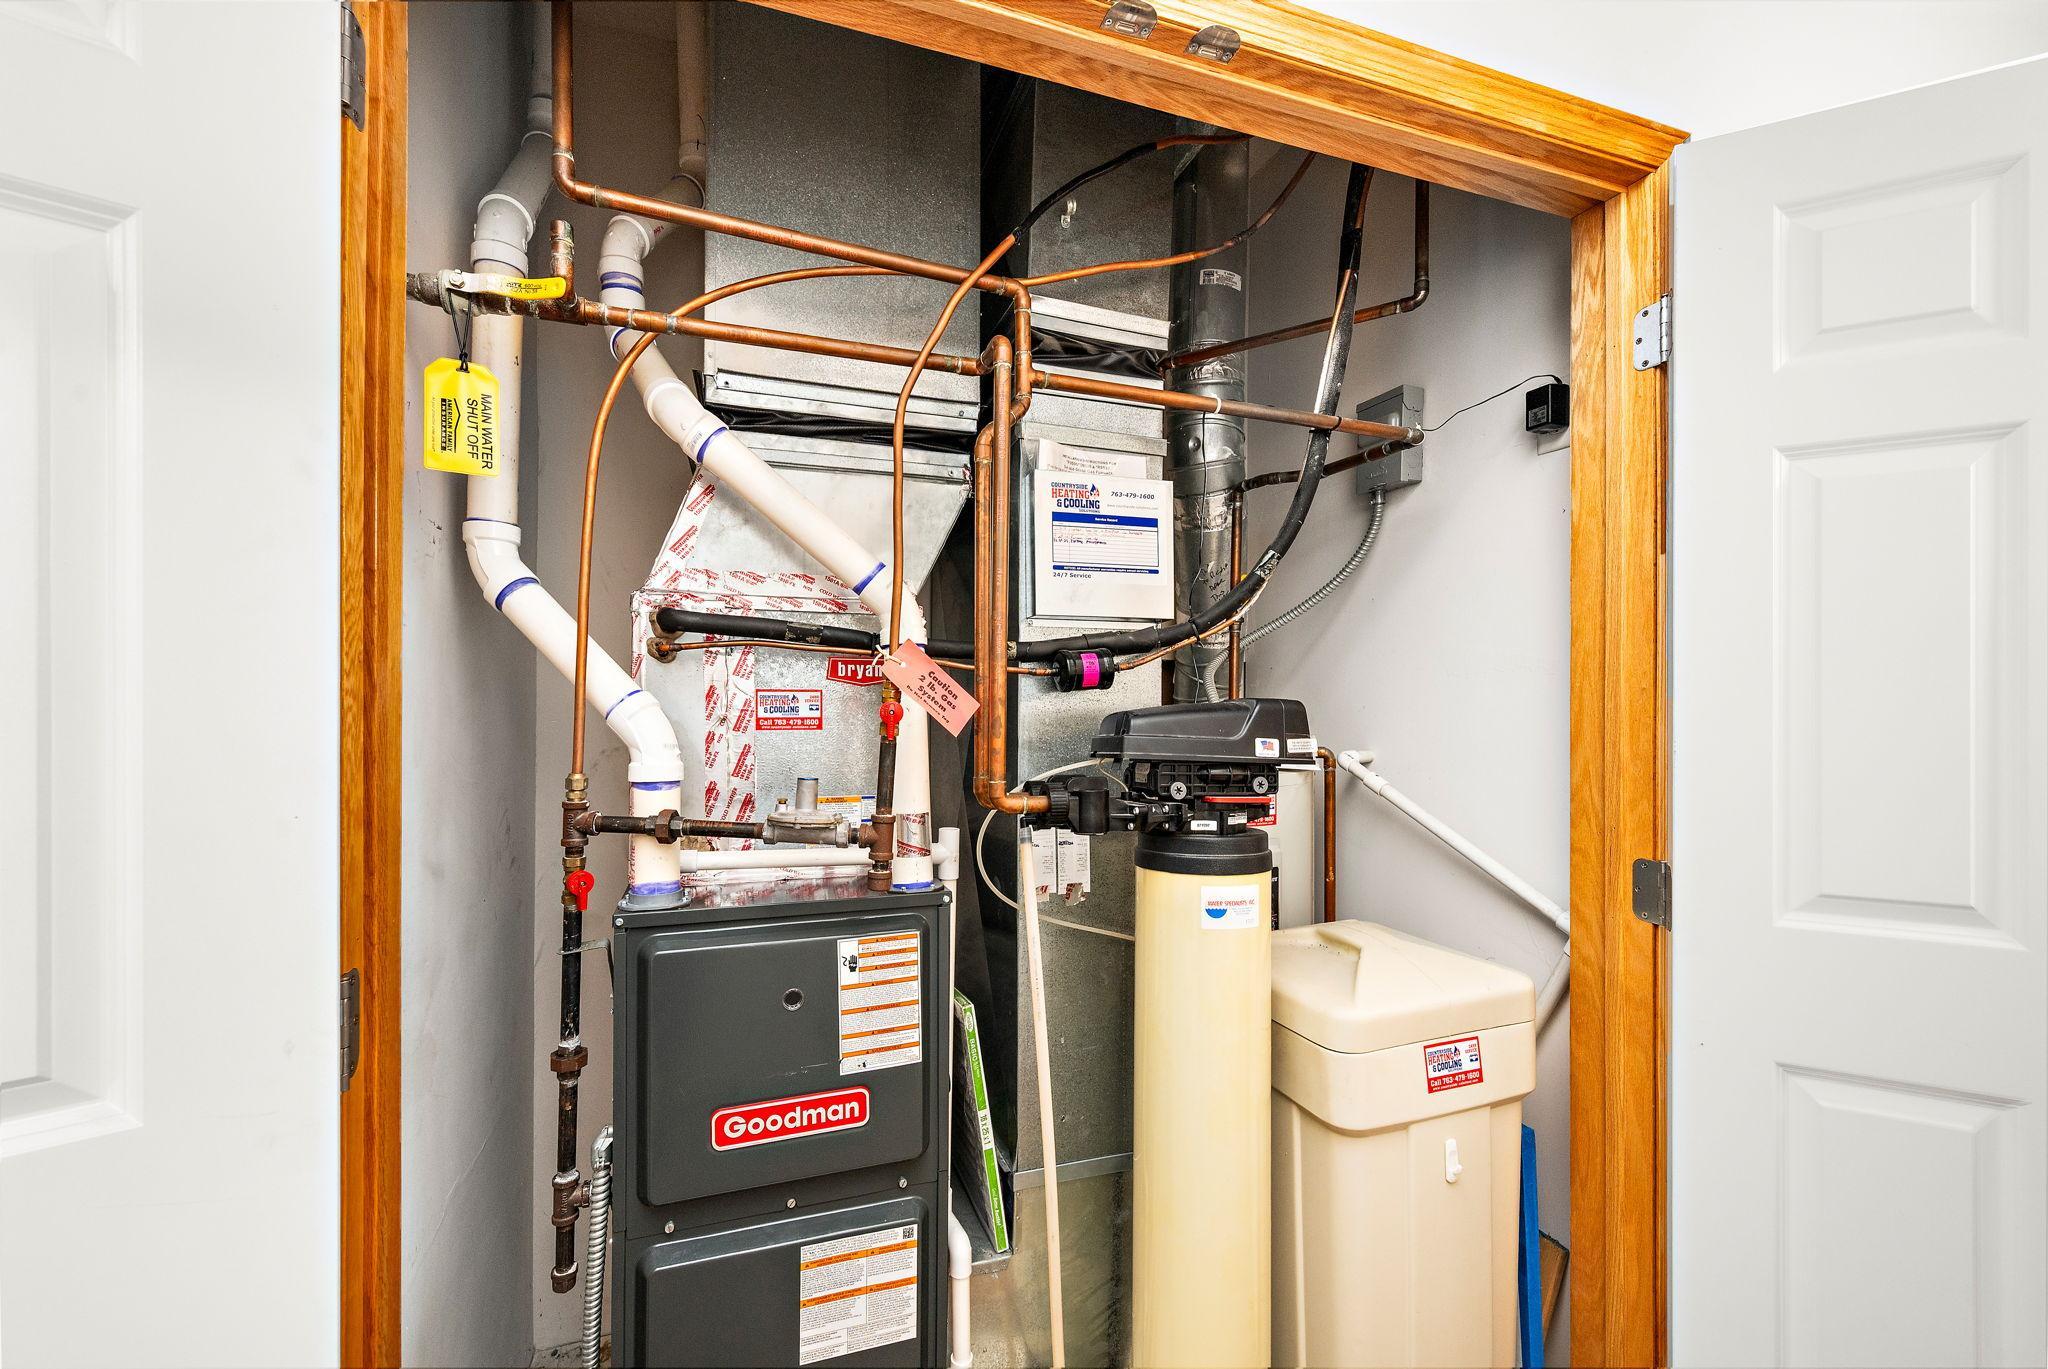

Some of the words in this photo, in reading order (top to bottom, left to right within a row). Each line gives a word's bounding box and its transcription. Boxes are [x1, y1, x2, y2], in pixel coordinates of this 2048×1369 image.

[467, 398, 478, 432] SHUT
[481, 394, 492, 425] MAIN
[467, 435, 479, 459] OFF
[481, 428, 493, 469] WATER
[1051, 482, 1088, 490] COUNTRYSIDE
[1051, 488, 1090, 499] HEATING
[1056, 499, 1062, 508] &
[1063, 498, 1100, 510] COOLING
[1111, 491, 1155, 500] 763-479-1600
[838, 661, 883, 679] bryan
[917, 675, 926, 683] 2
[926, 682, 938, 695] lb.
[940, 694, 957, 710] Gas
[928, 671, 958, 701] Caution
[760, 698, 791, 707] HEATING
[913, 691, 923, 701] Not
[941, 715, 950, 724] Tag
[917, 685, 947, 713] System
[769, 705, 800, 714] COOLING
[970, 1038, 978, 1062] BASIC
[1428, 1053, 1454, 1066] HEATING
[1437, 1059, 1462, 1072] COOLING
[1431, 1078, 1442, 1087] Call
[724, 1101, 860, 1139] Goodman
[980, 1114, 987, 1122] 16
